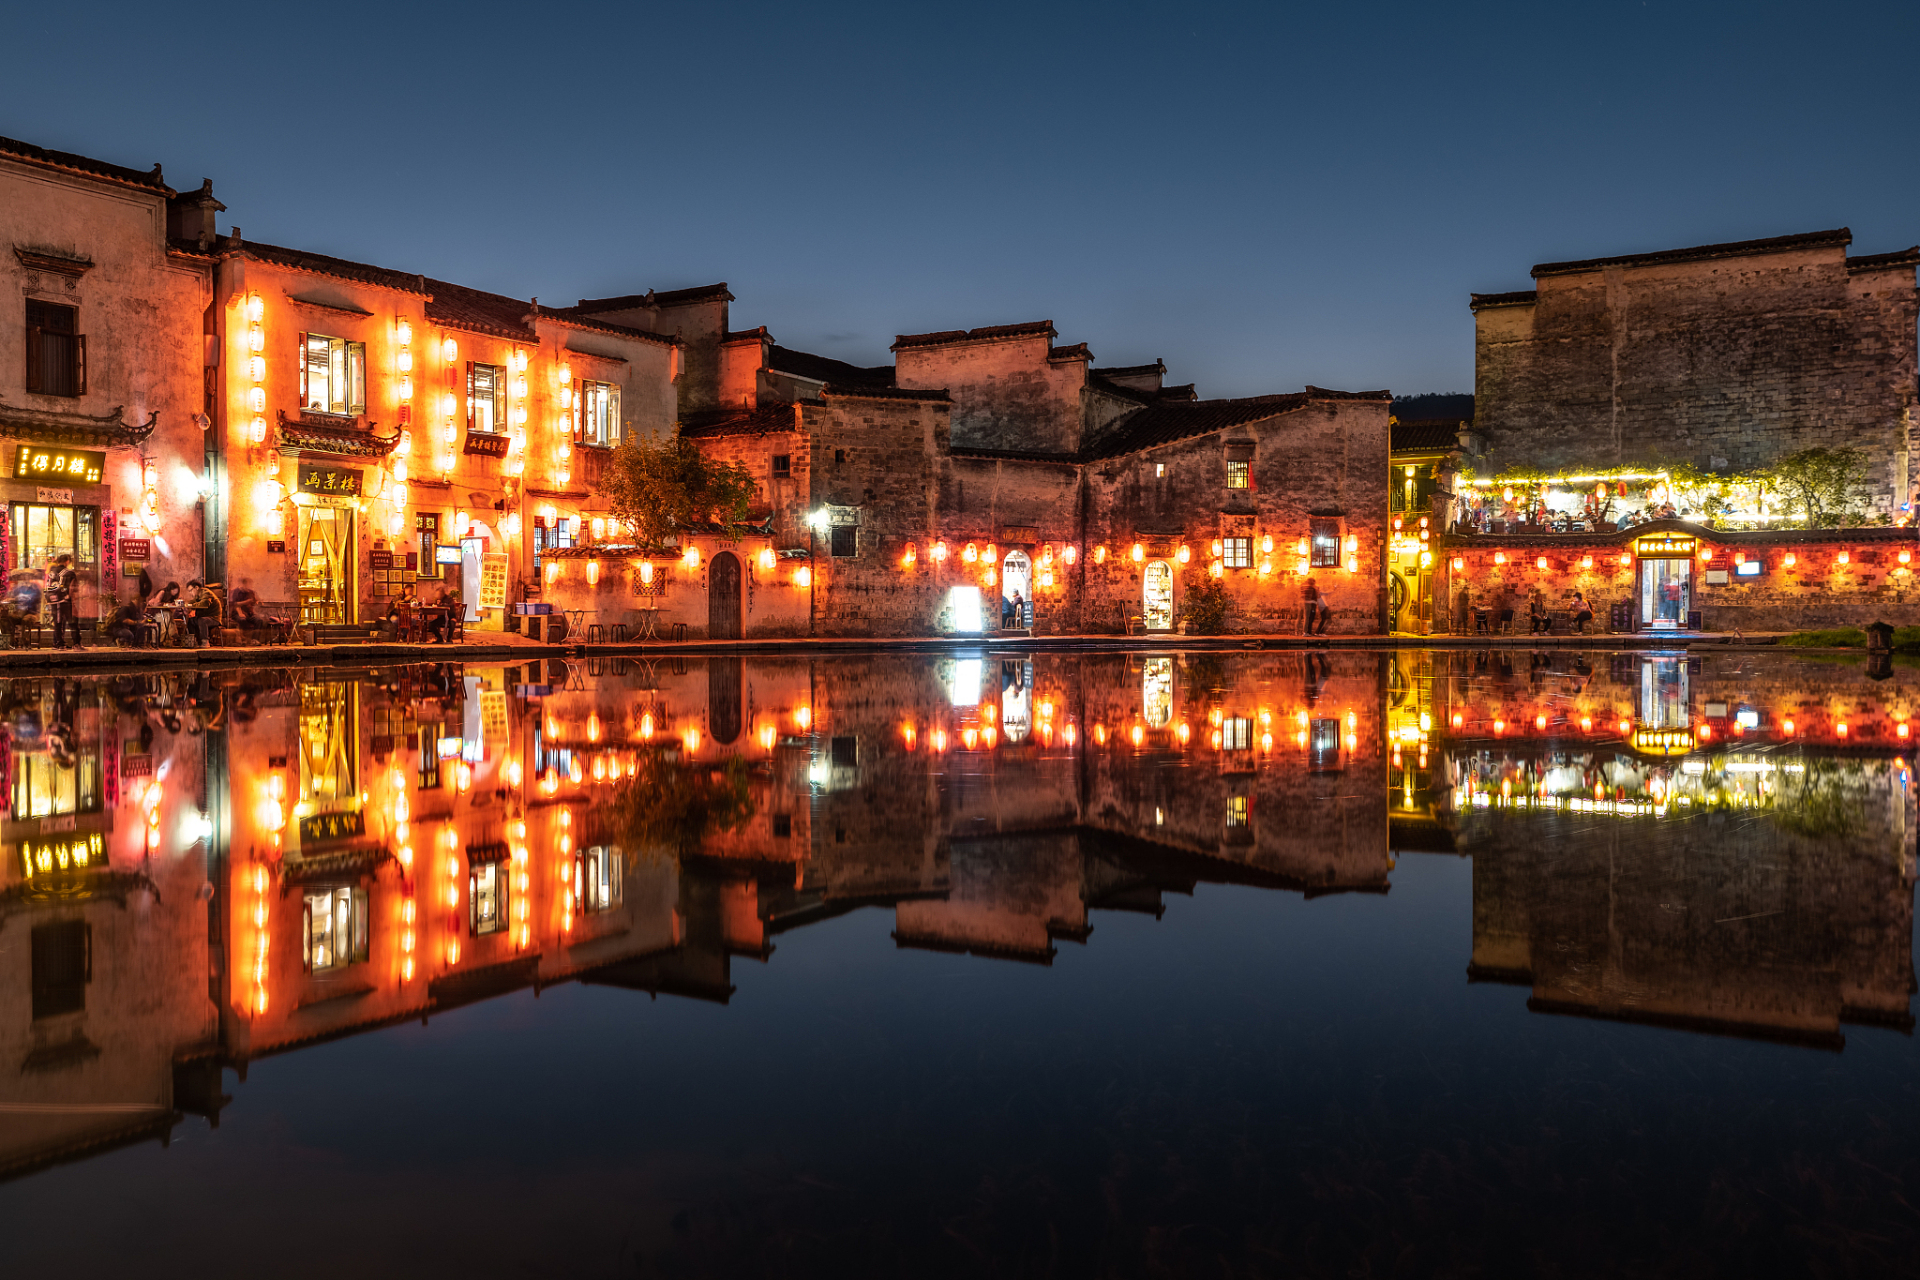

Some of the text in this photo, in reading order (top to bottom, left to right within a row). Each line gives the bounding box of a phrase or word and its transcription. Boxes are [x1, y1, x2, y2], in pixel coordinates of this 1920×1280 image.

[31, 454, 86, 474] 得月楼
[304, 471, 355, 491] 画景楼
